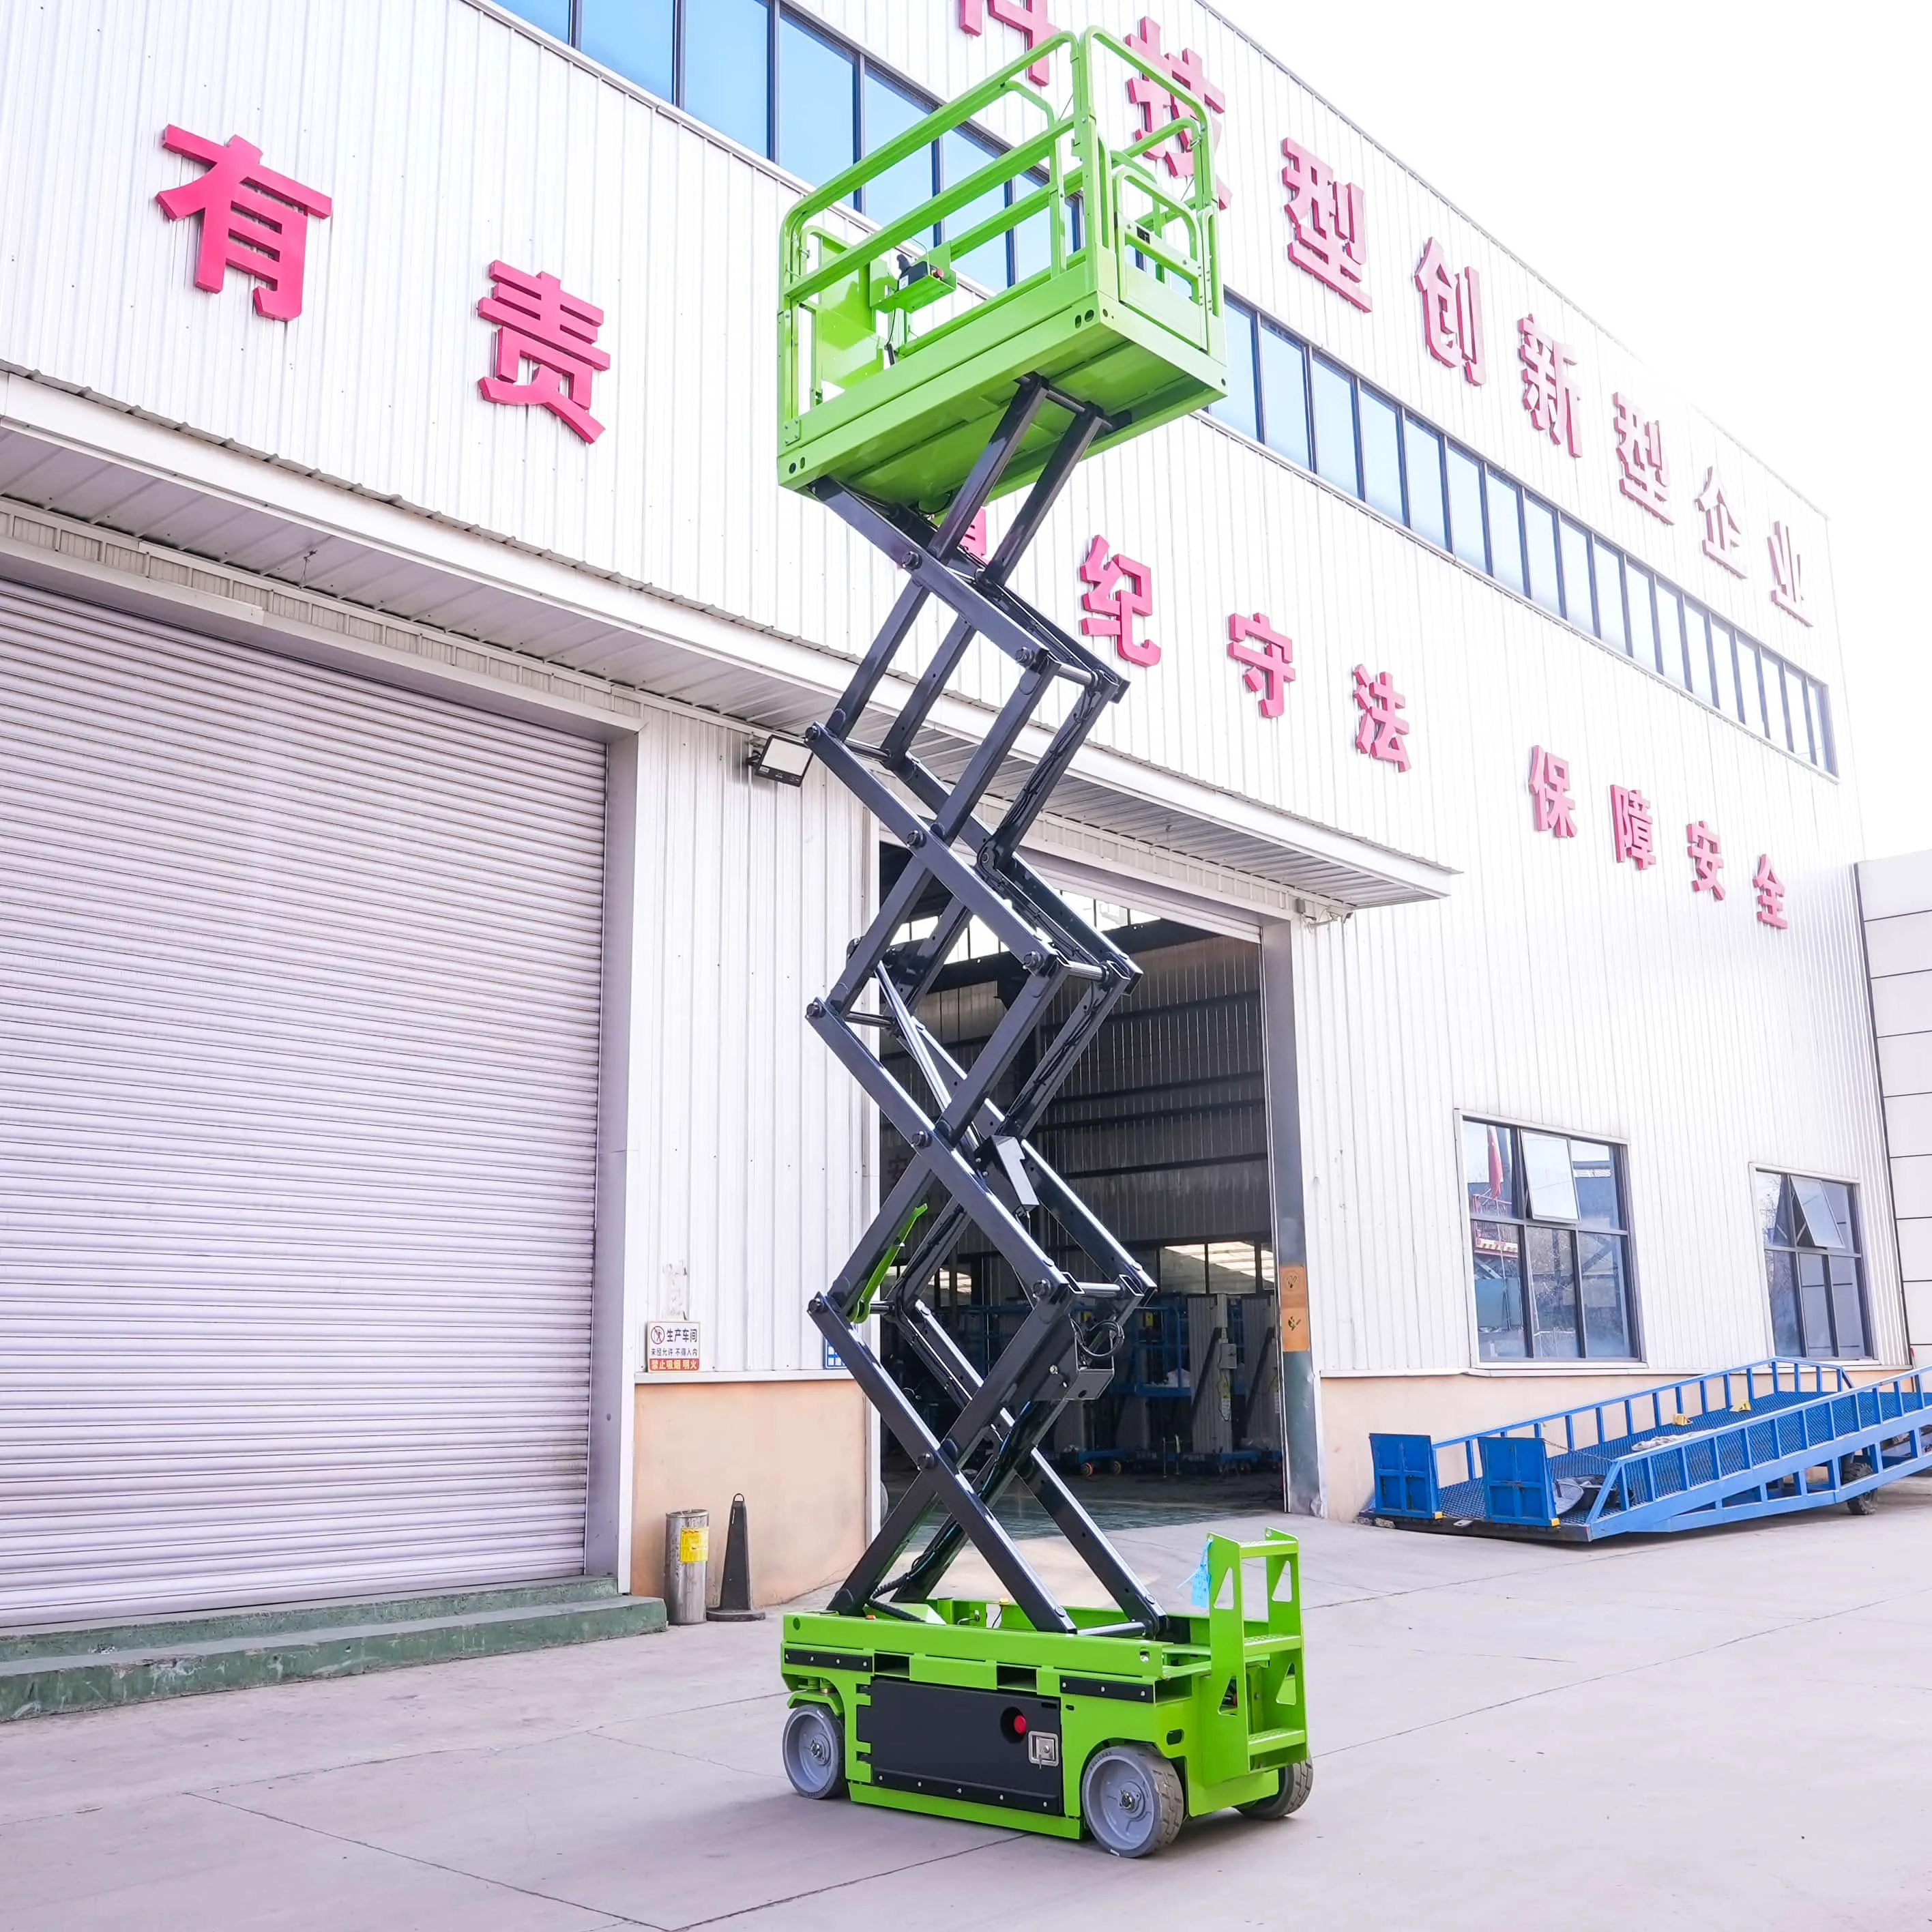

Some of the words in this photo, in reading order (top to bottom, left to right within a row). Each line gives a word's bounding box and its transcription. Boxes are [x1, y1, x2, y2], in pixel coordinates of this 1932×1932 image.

[153, 124, 611, 445] 有责
[1529, 745, 1788, 929] 保障安全
[667, 1328, 698, 1343] 生产车间
